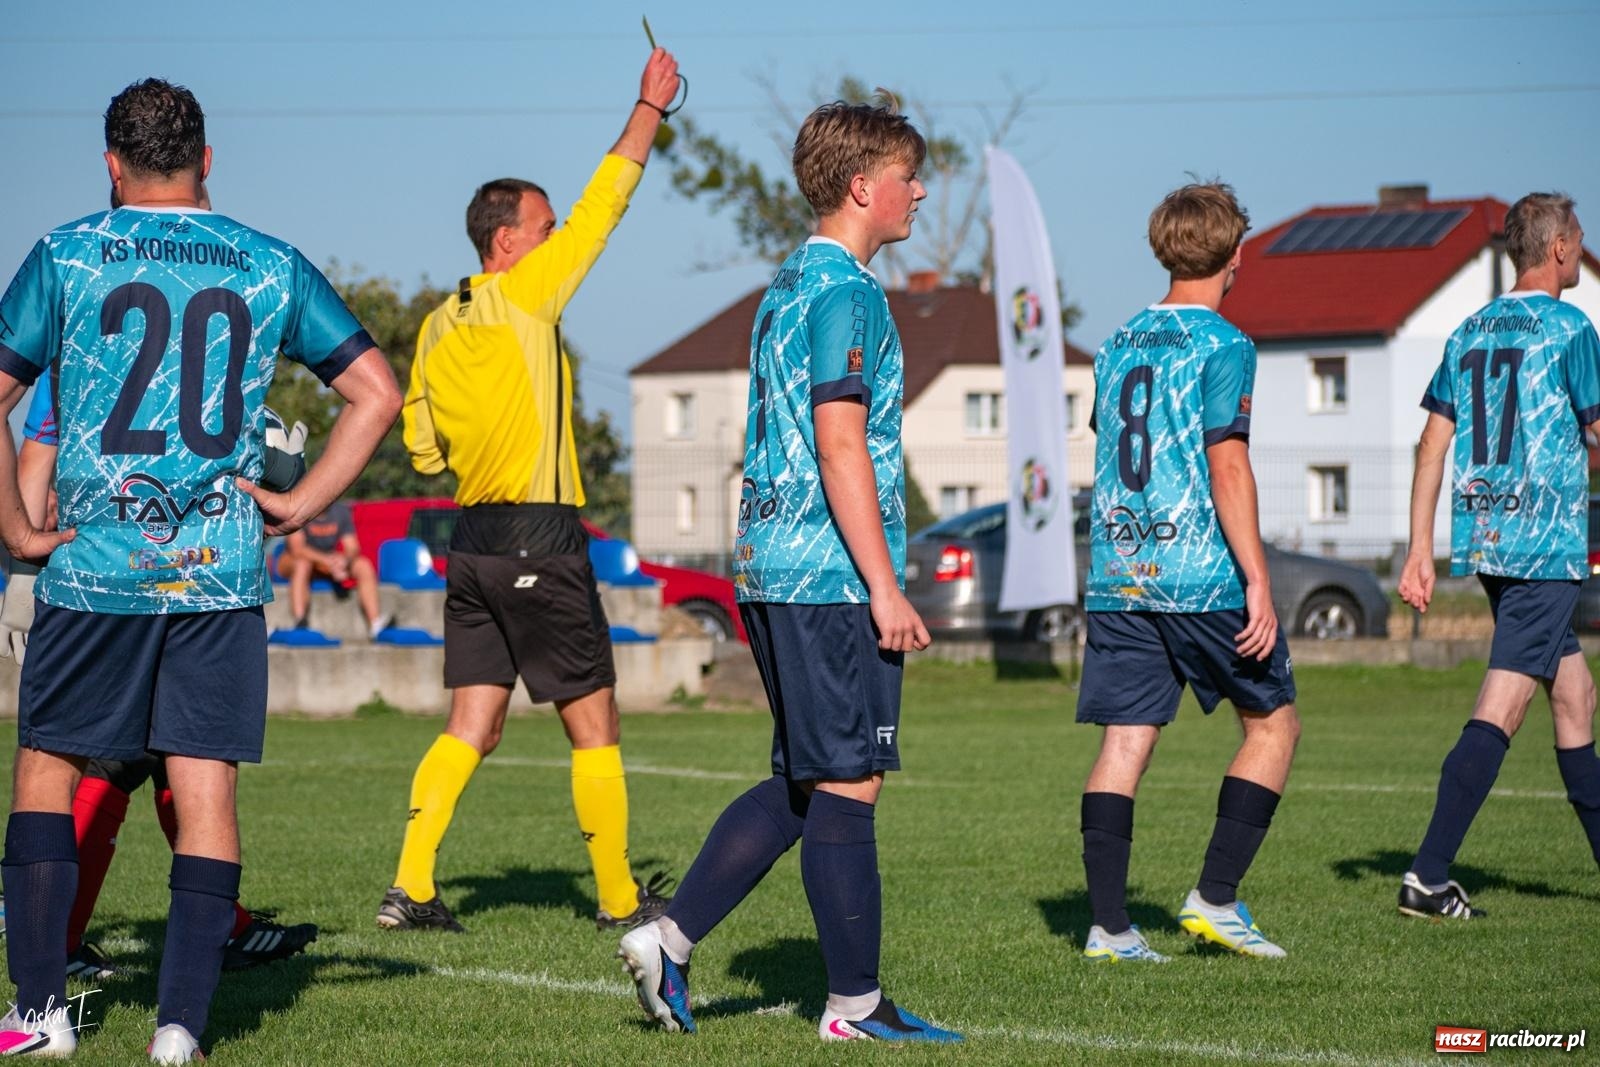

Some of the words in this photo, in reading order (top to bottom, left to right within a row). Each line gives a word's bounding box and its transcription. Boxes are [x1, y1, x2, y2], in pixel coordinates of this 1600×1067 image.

[159, 221, 191, 233] 1922
[101, 239, 128, 264] KS
[134, 238, 251, 272] KORNOWAC
[1478, 315, 1542, 335] KORNOWAC
[1127, 329, 1192, 349] KORNOWAC
[100, 282, 253, 460] 20
[1459, 348, 1525, 465] 17
[1118, 365, 1153, 492] 8
[108, 491, 228, 523] TAVO
[1461, 494, 1520, 511] TAVO
[1105, 522, 1177, 541] TAVO
